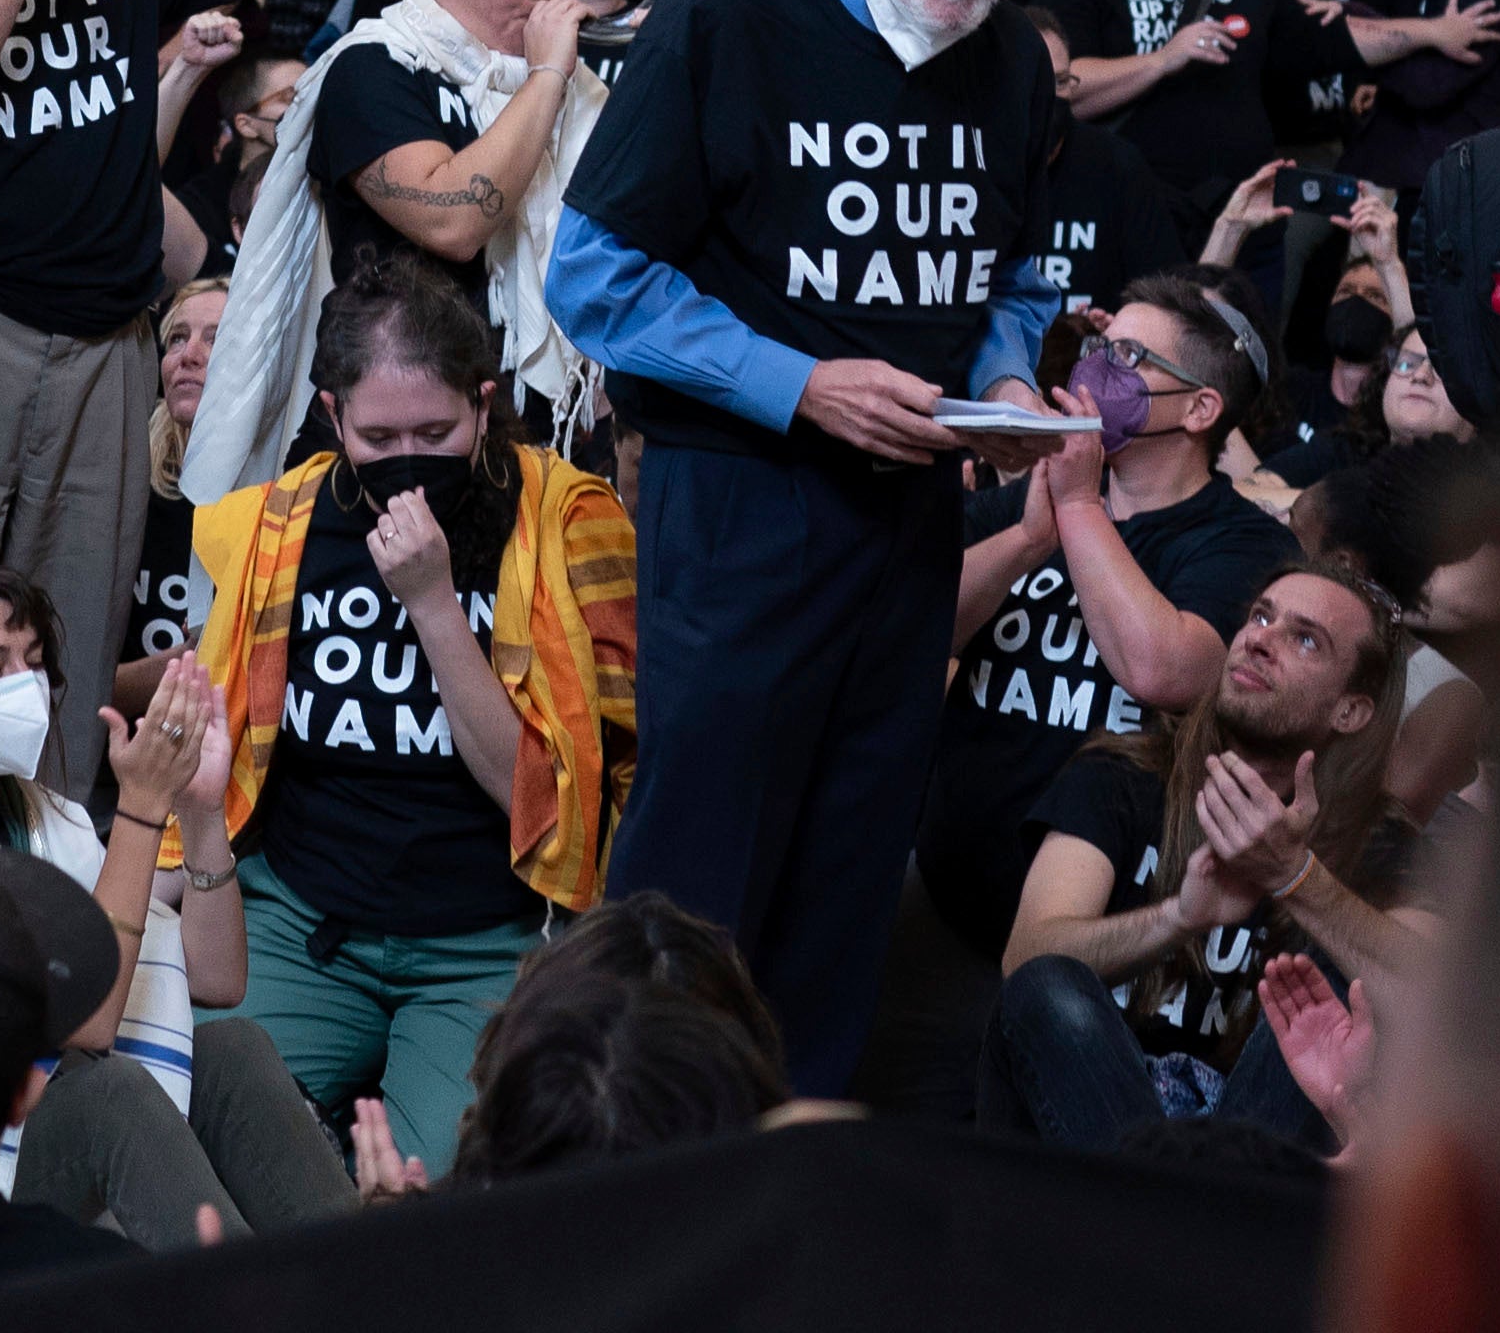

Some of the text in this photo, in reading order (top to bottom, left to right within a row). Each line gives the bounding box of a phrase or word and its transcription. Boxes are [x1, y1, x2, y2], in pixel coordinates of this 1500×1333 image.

[1128, 0, 1164, 21] UP
[1132, 19, 1178, 44] RAC
[0, 15, 117, 83] OUR
[788, 121, 926, 169] NOT
[826, 180, 978, 237] OUR
[1053, 220, 1096, 250] IN
[785, 246, 997, 306] NAME
[132, 569, 189, 611] NO
[312, 634, 440, 695] OU
[281, 682, 454, 758] NAM
[968, 658, 1143, 735] NAME
